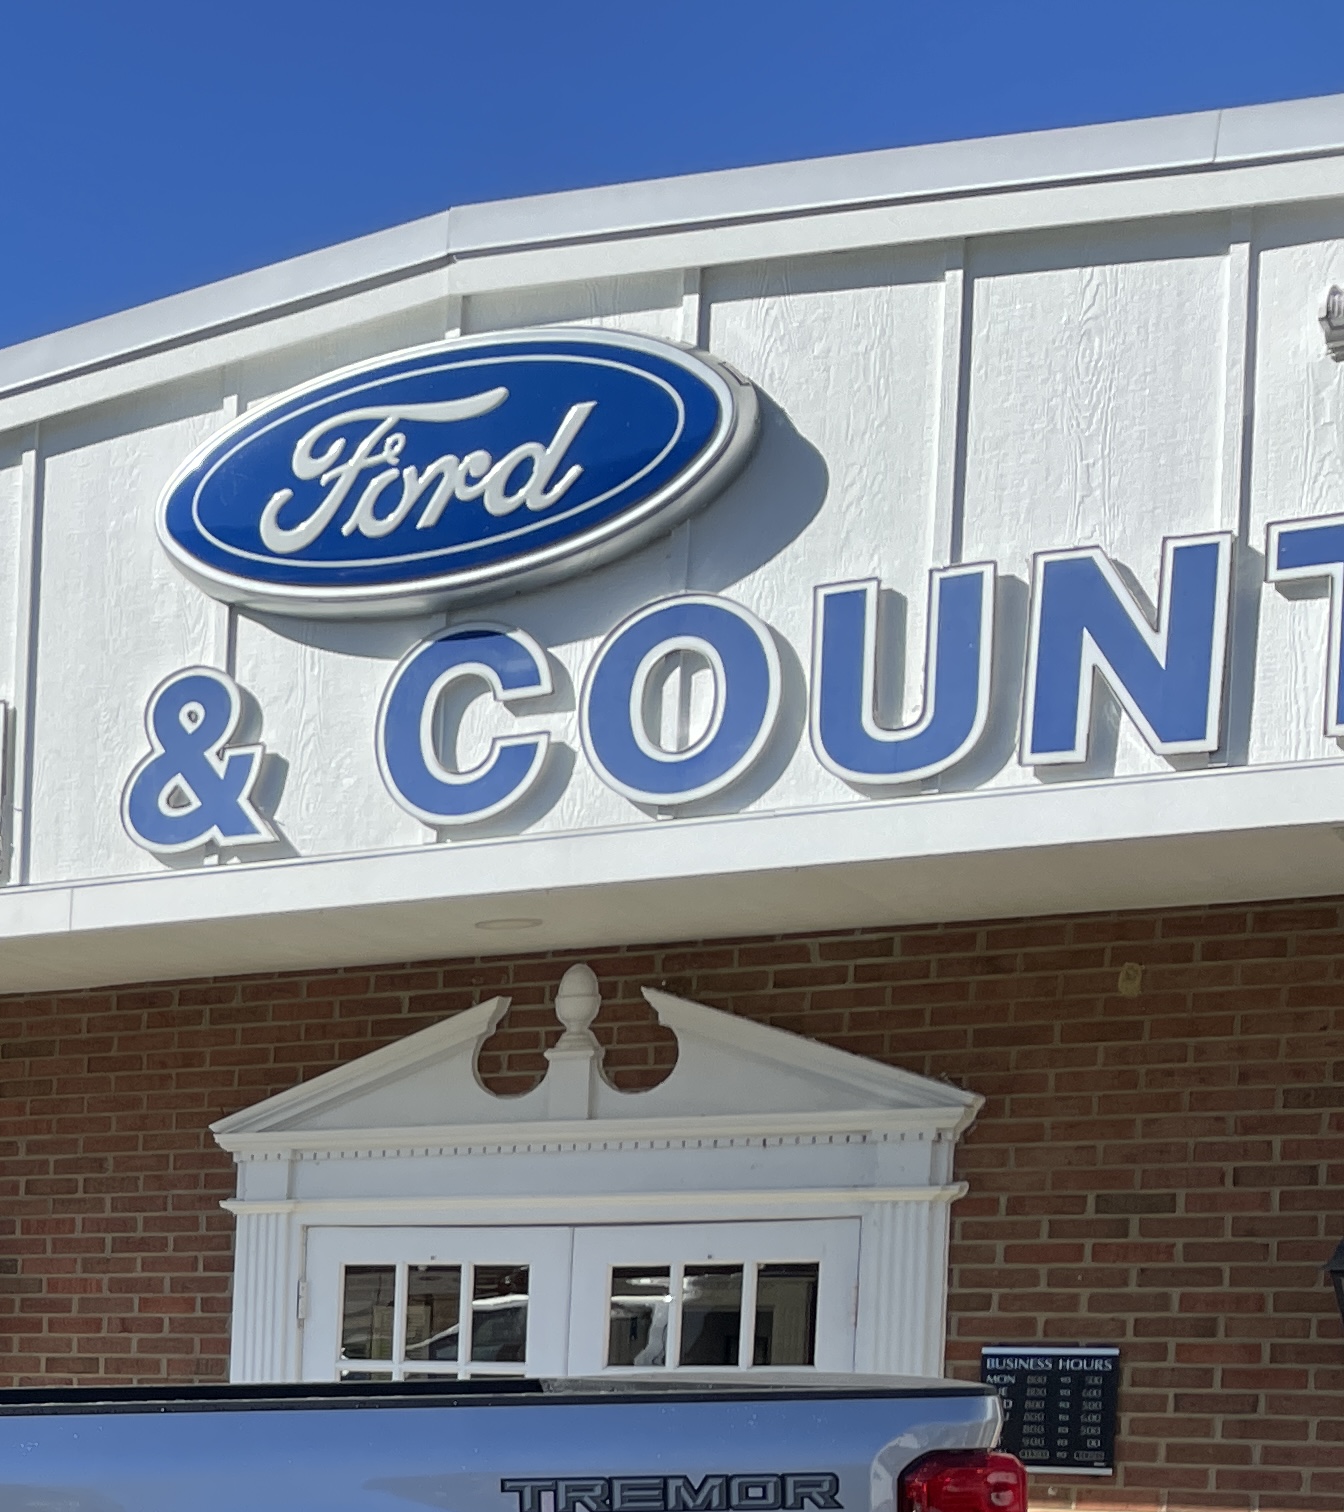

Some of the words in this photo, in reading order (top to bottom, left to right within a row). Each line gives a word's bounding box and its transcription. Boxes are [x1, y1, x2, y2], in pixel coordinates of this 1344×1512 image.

[260, 387, 597, 554] Ford
[120, 665, 280, 855] &
[986, 1357, 1053, 1371] BUSINESS
[1058, 1357, 1113, 1372] HOURS
